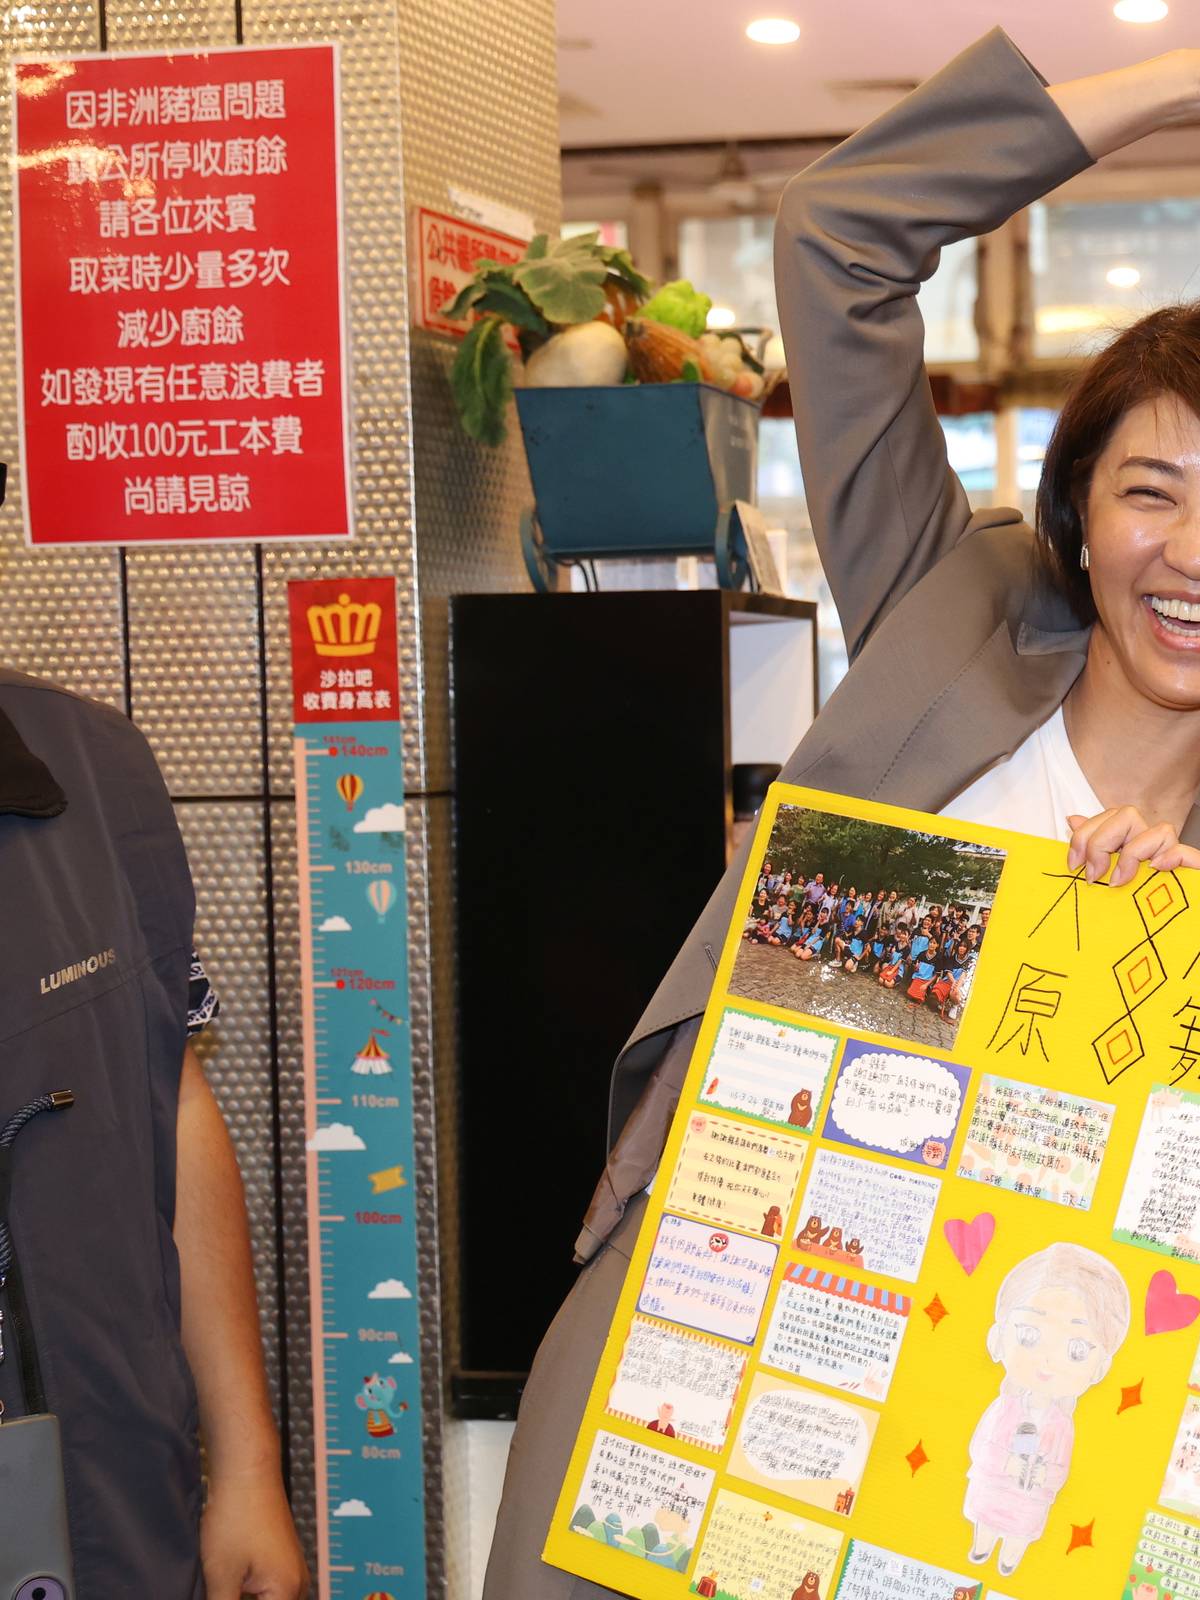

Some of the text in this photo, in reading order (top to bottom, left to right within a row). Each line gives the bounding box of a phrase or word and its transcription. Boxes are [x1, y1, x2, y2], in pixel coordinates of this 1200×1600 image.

[66, 80, 286, 129] 因非洲豬瘟問題
[100, 194, 256, 238] 請各位來賓
[69, 248, 290, 295] 取菜時少量多次
[118, 305, 244, 348] 減少廚餘
[41, 359, 325, 407] 如發現有任意浪費者
[66, 417, 303, 460] 酌收100元工本費
[125, 474, 250, 515] 尚請見諒
[320, 669, 373, 688] 沙拉吧
[303, 690, 391, 711] 收費身高表
[345, 861, 392, 874] 130cm
[41, 949, 116, 994] LUMINOUS
[352, 1095, 399, 1107] 110cm
[355, 1212, 402, 1224] 100cm
[358, 1329, 398, 1342] 90cm
[361, 1447, 400, 1459] 80cm
[364, 1563, 404, 1576] 70cm
